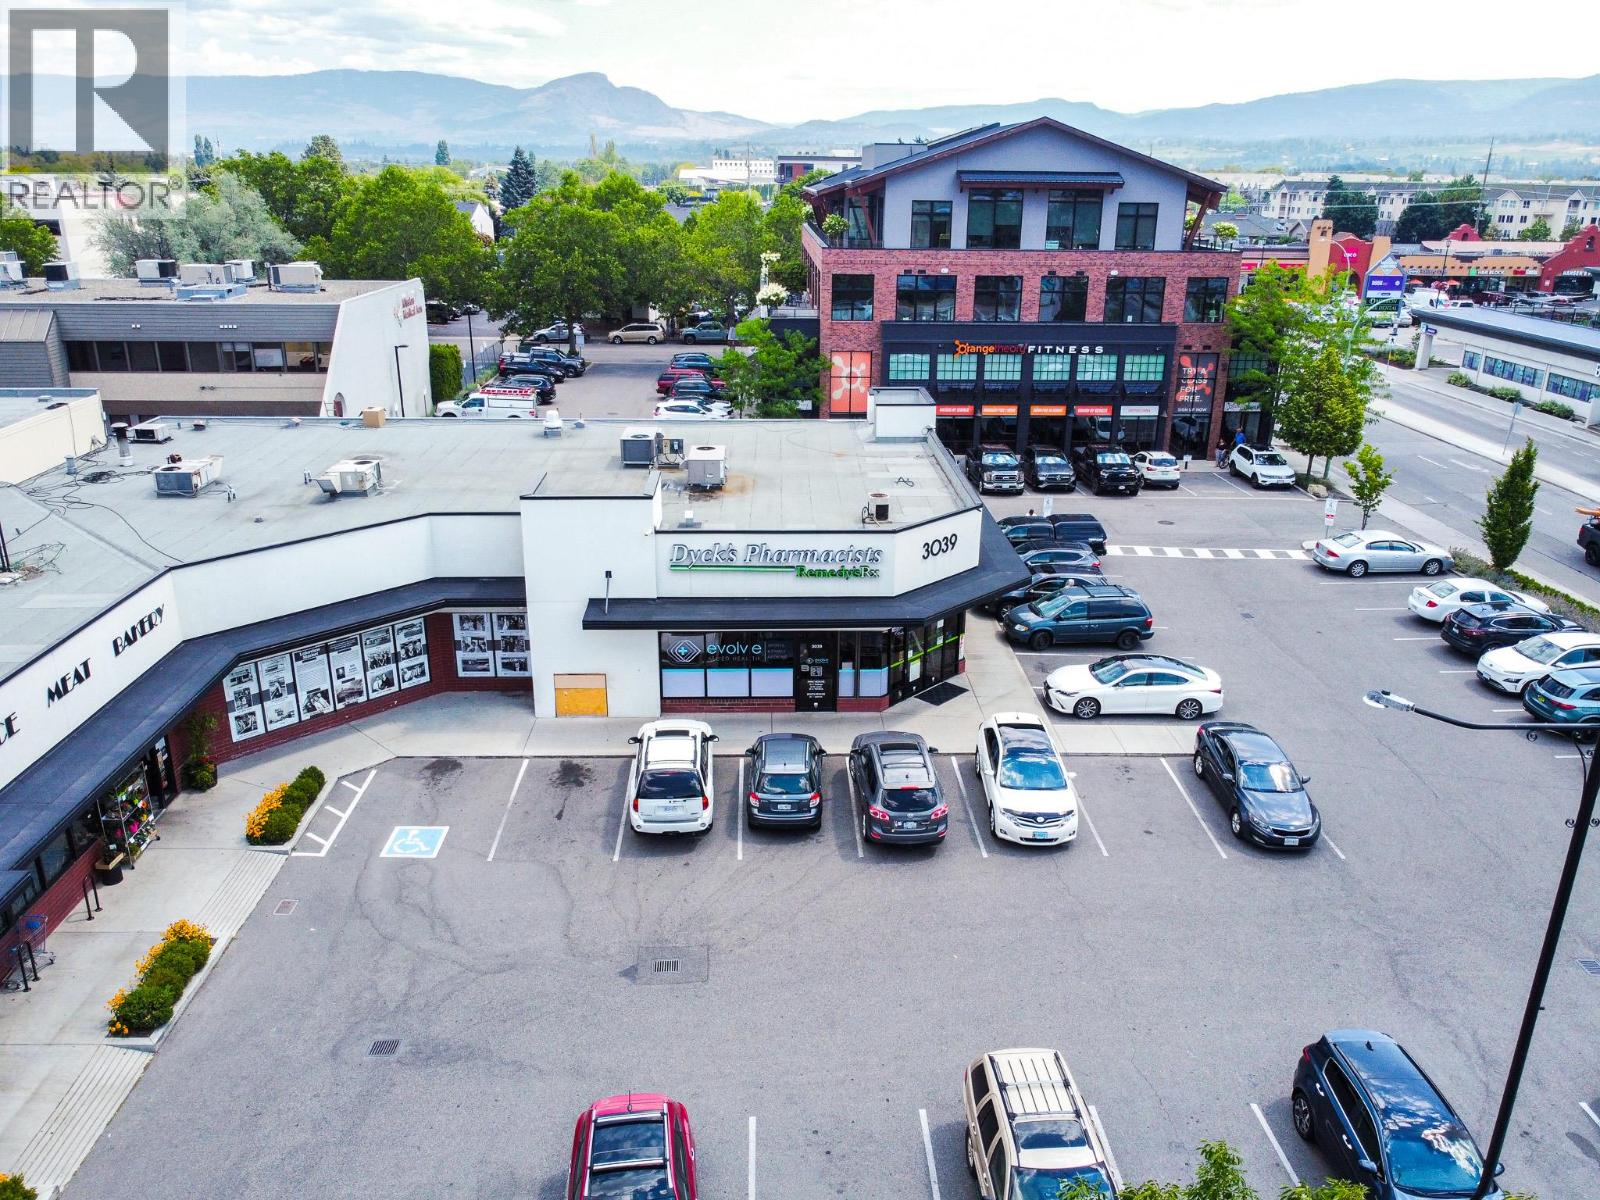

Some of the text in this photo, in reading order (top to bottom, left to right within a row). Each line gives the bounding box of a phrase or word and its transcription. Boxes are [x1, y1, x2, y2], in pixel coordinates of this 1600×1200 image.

[1027, 345, 1104, 354] FITNESS
[1182, 367, 1208, 375] TRY A
[669, 543, 883, 569] Dyck's Pharmacists
[922, 533, 958, 560] 3039
[47, 657, 91, 708] MEAT
[112, 603, 165, 657] BAKERY
[706, 641, 762, 655] evolve
